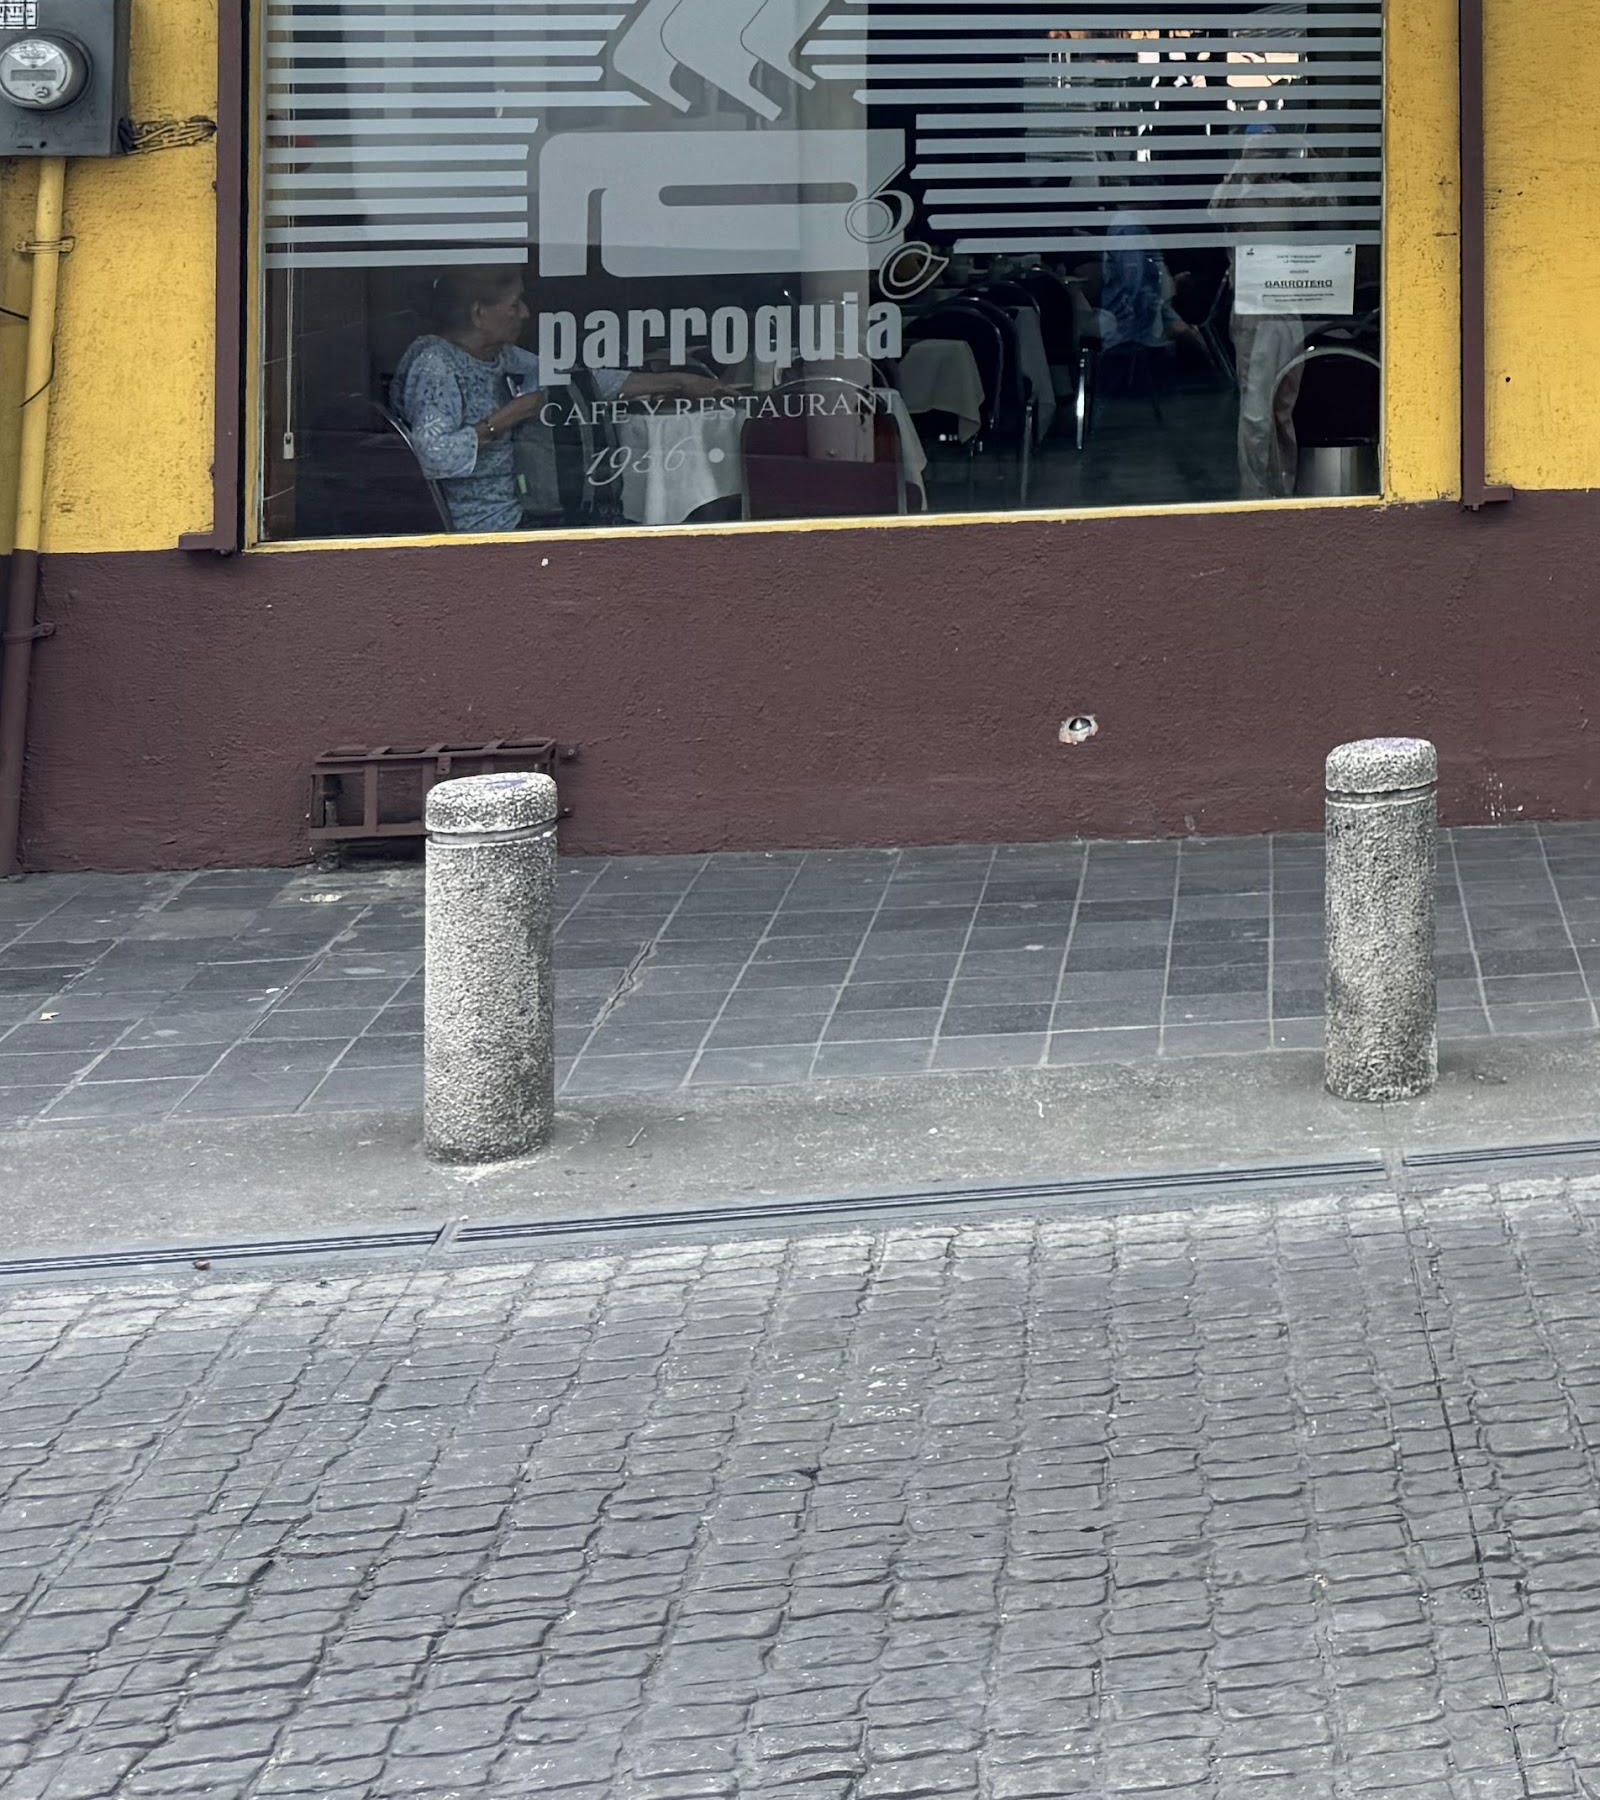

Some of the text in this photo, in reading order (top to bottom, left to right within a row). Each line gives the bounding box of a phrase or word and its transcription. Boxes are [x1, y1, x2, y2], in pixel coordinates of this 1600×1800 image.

[539, 292, 902, 386] parroquia
[539, 393, 897, 428] CAFÉ Y RESTAURANT
[585, 436, 701, 487] 1956
